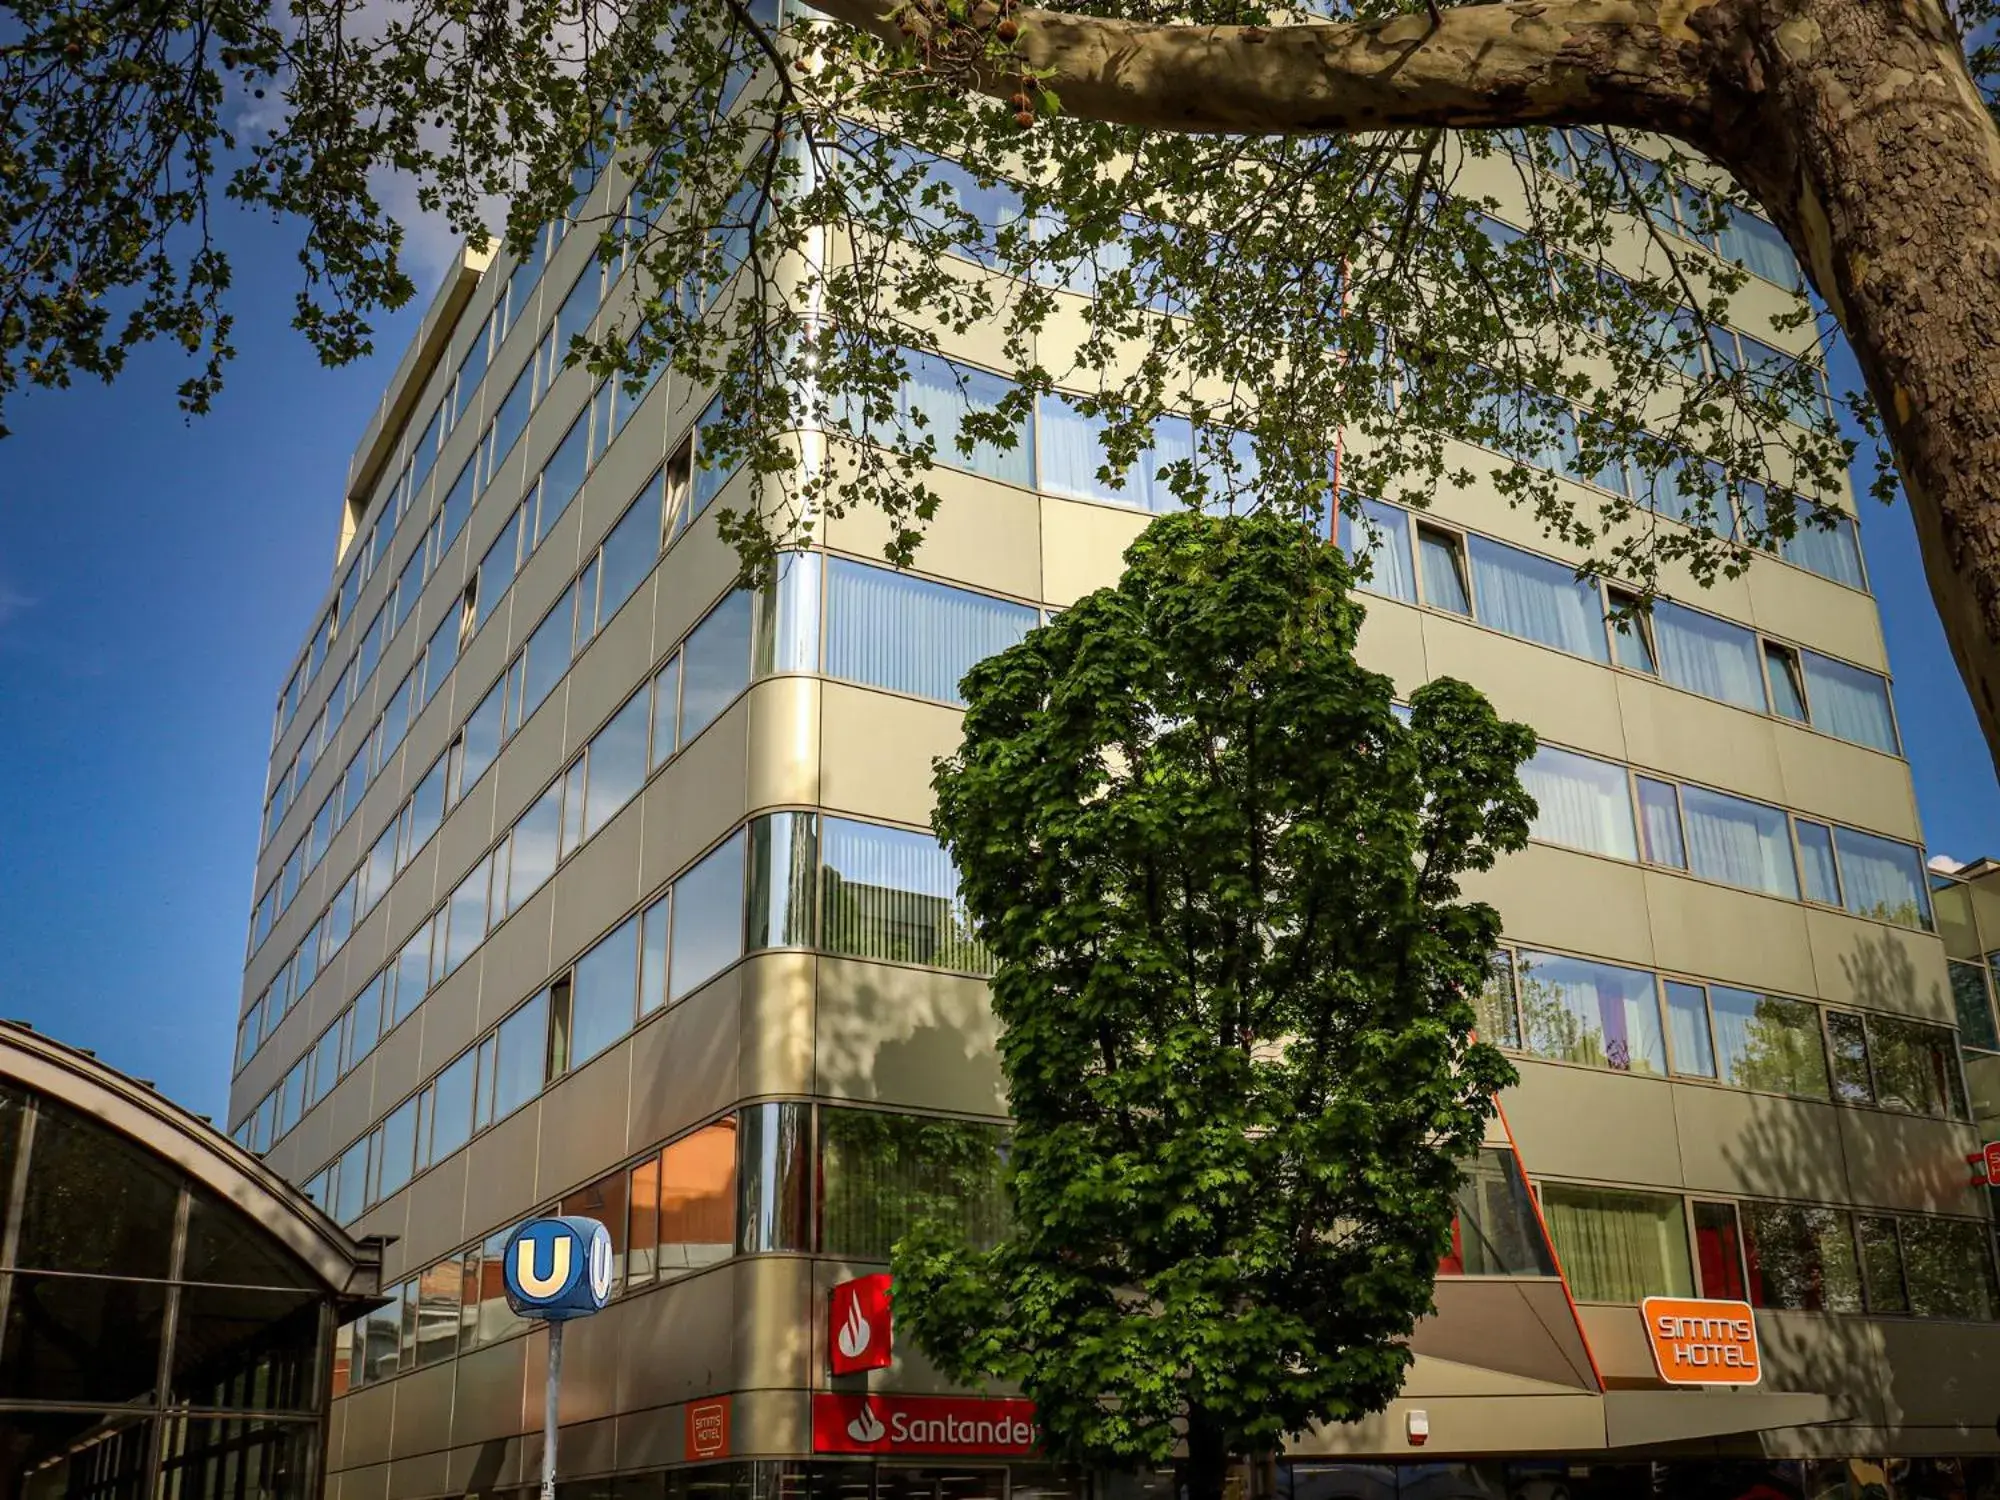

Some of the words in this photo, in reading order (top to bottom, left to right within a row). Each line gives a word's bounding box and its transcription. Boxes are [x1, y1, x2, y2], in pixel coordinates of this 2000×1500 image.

[518, 1236, 571, 1298] U
[594, 1236, 612, 1300] U
[1674, 1343, 1755, 1367] HOTEL
